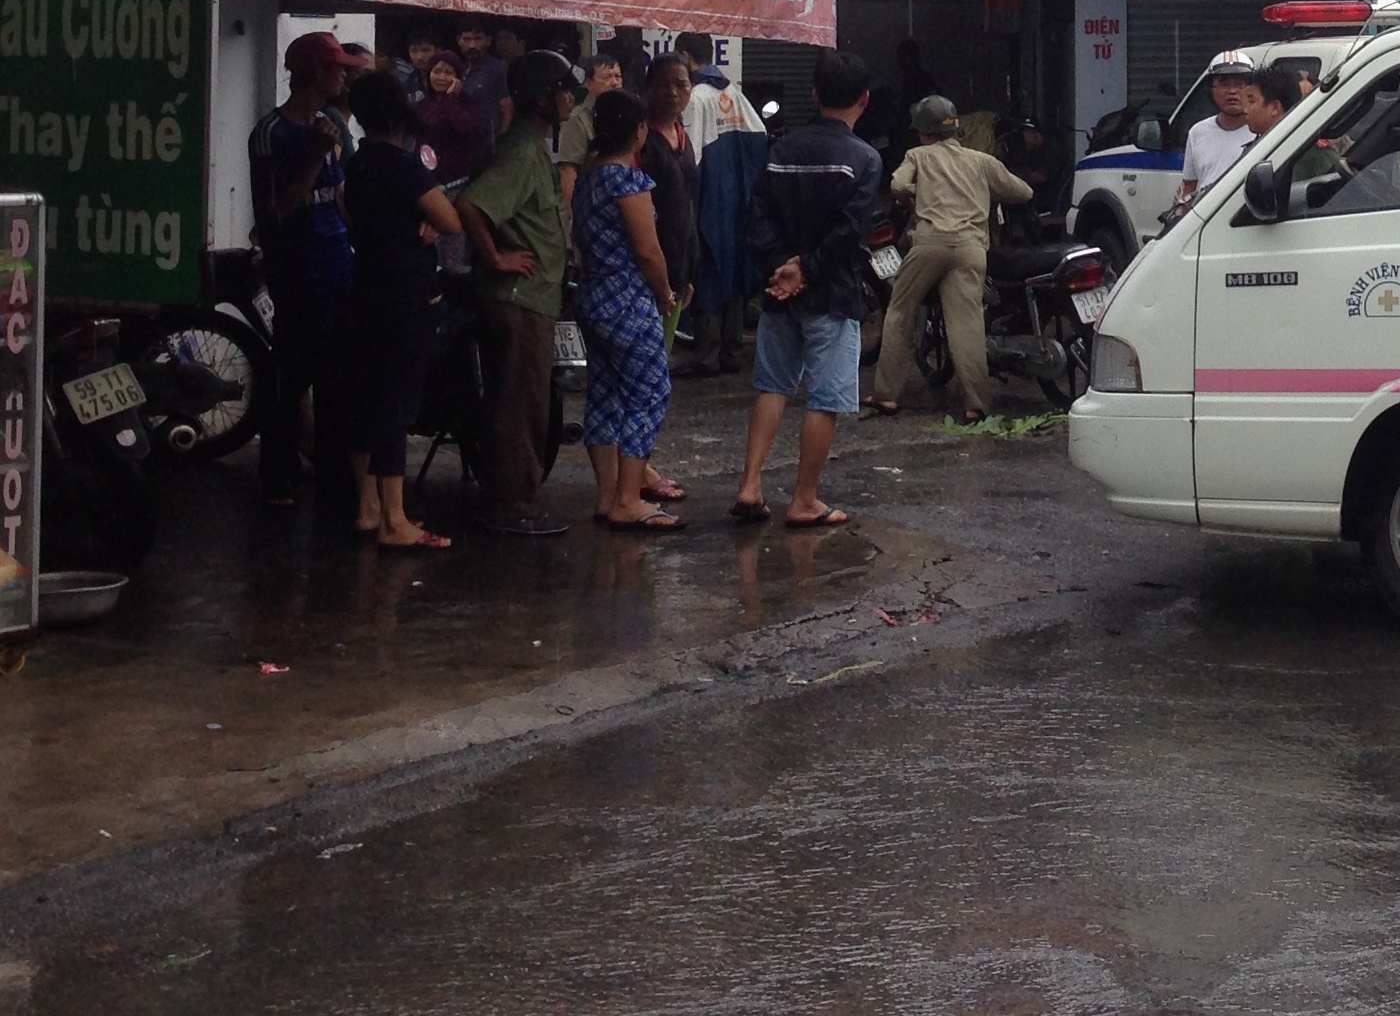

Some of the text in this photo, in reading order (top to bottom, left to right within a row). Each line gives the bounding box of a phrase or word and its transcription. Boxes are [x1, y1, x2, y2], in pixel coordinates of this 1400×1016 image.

[105, 92, 184, 163] thế
[74, 192, 182, 271] tùng
[1345, 277, 1370, 317] BỆNH
[1365, 261, 1400, 281] VIỆN
